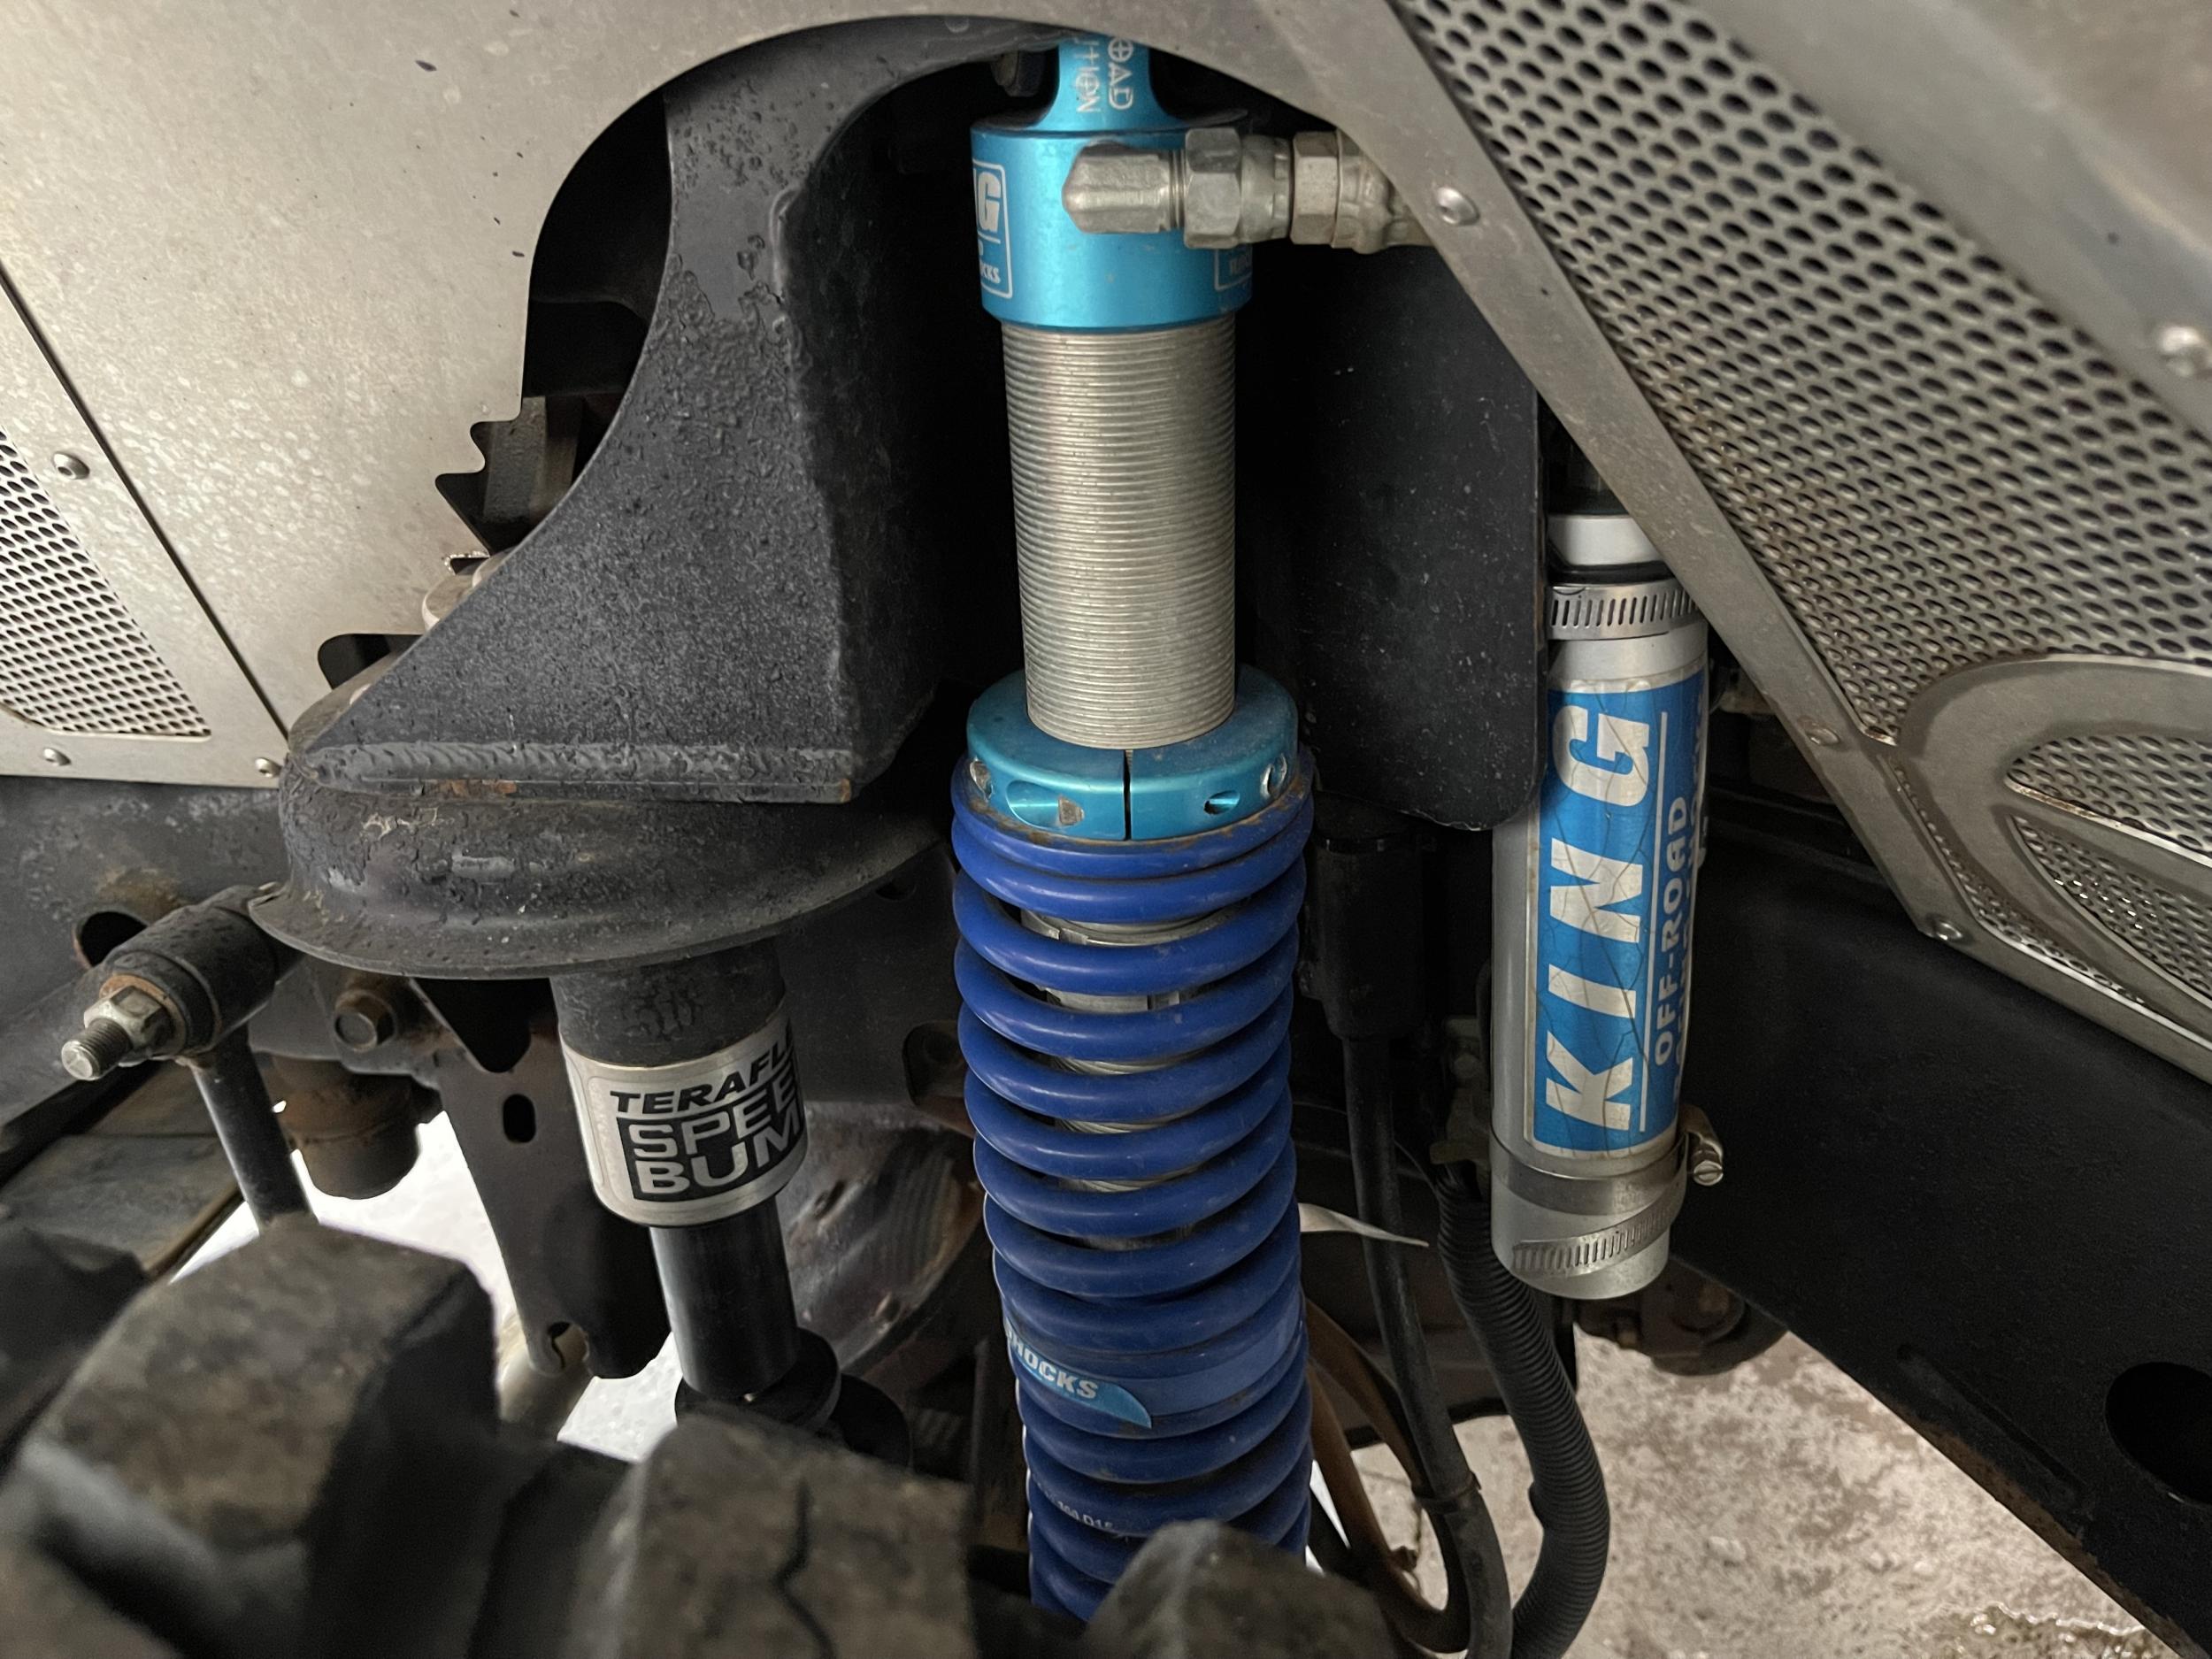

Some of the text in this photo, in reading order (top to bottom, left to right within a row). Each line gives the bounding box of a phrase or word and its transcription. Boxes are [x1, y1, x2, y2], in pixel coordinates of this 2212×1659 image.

[1108, 38, 1133, 111] OAD
[1546, 705, 1650, 1131] KING
[1655, 797, 1686, 1066] OFF-ROAD
[610, 1019, 793, 1114] TERAFL
